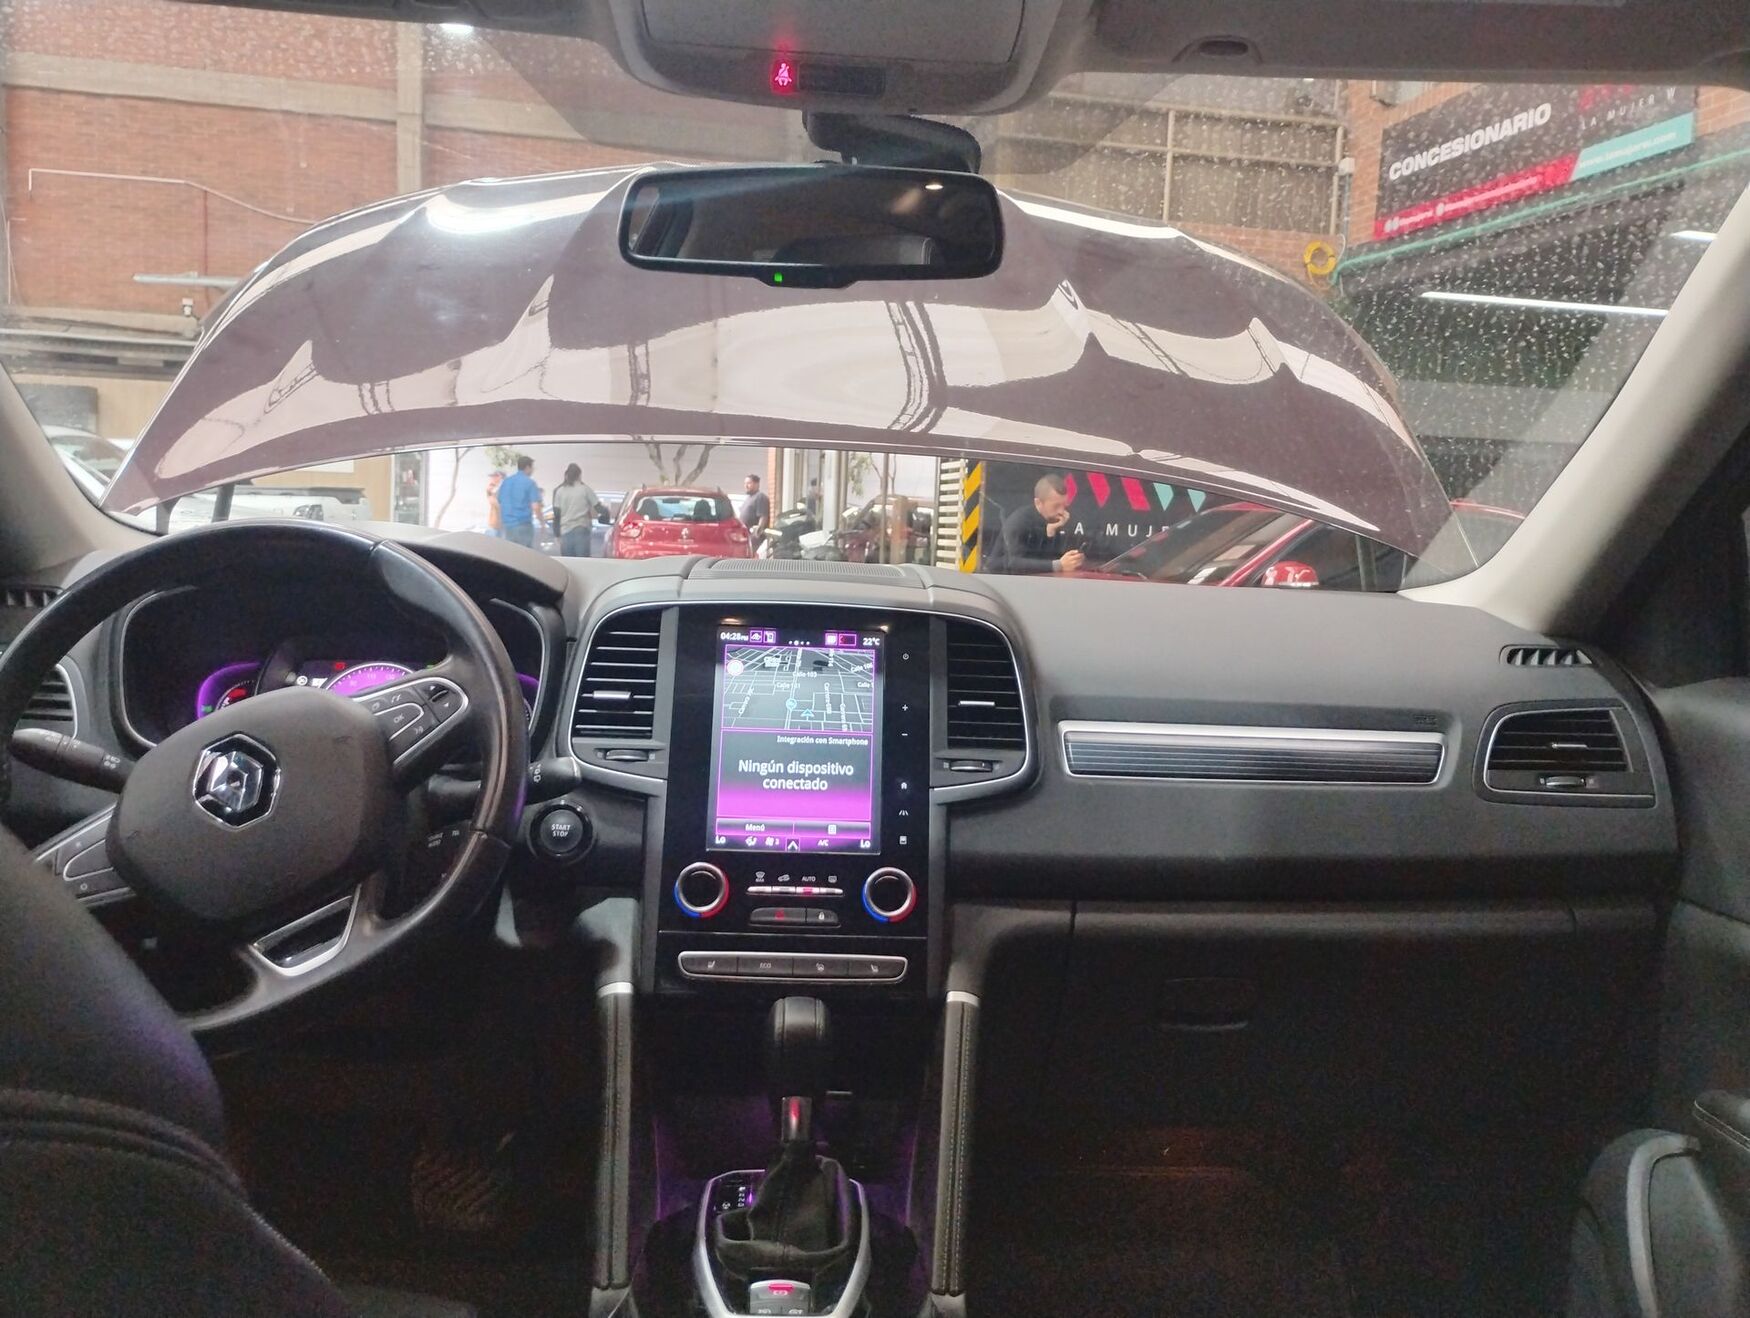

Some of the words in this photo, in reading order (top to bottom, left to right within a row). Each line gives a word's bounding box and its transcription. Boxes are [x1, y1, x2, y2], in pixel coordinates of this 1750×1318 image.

[1388, 102, 1552, 181] CONCESIONARIO
[777, 735, 814, 745] Integración
[828, 737, 868, 747] Smartphone
[738, 759, 784, 776] Ningún
[787, 760, 854, 777] dispositivo
[762, 777, 828, 791] conectado
[551, 823, 571, 831] START
[745, 823, 765, 832] Menú
